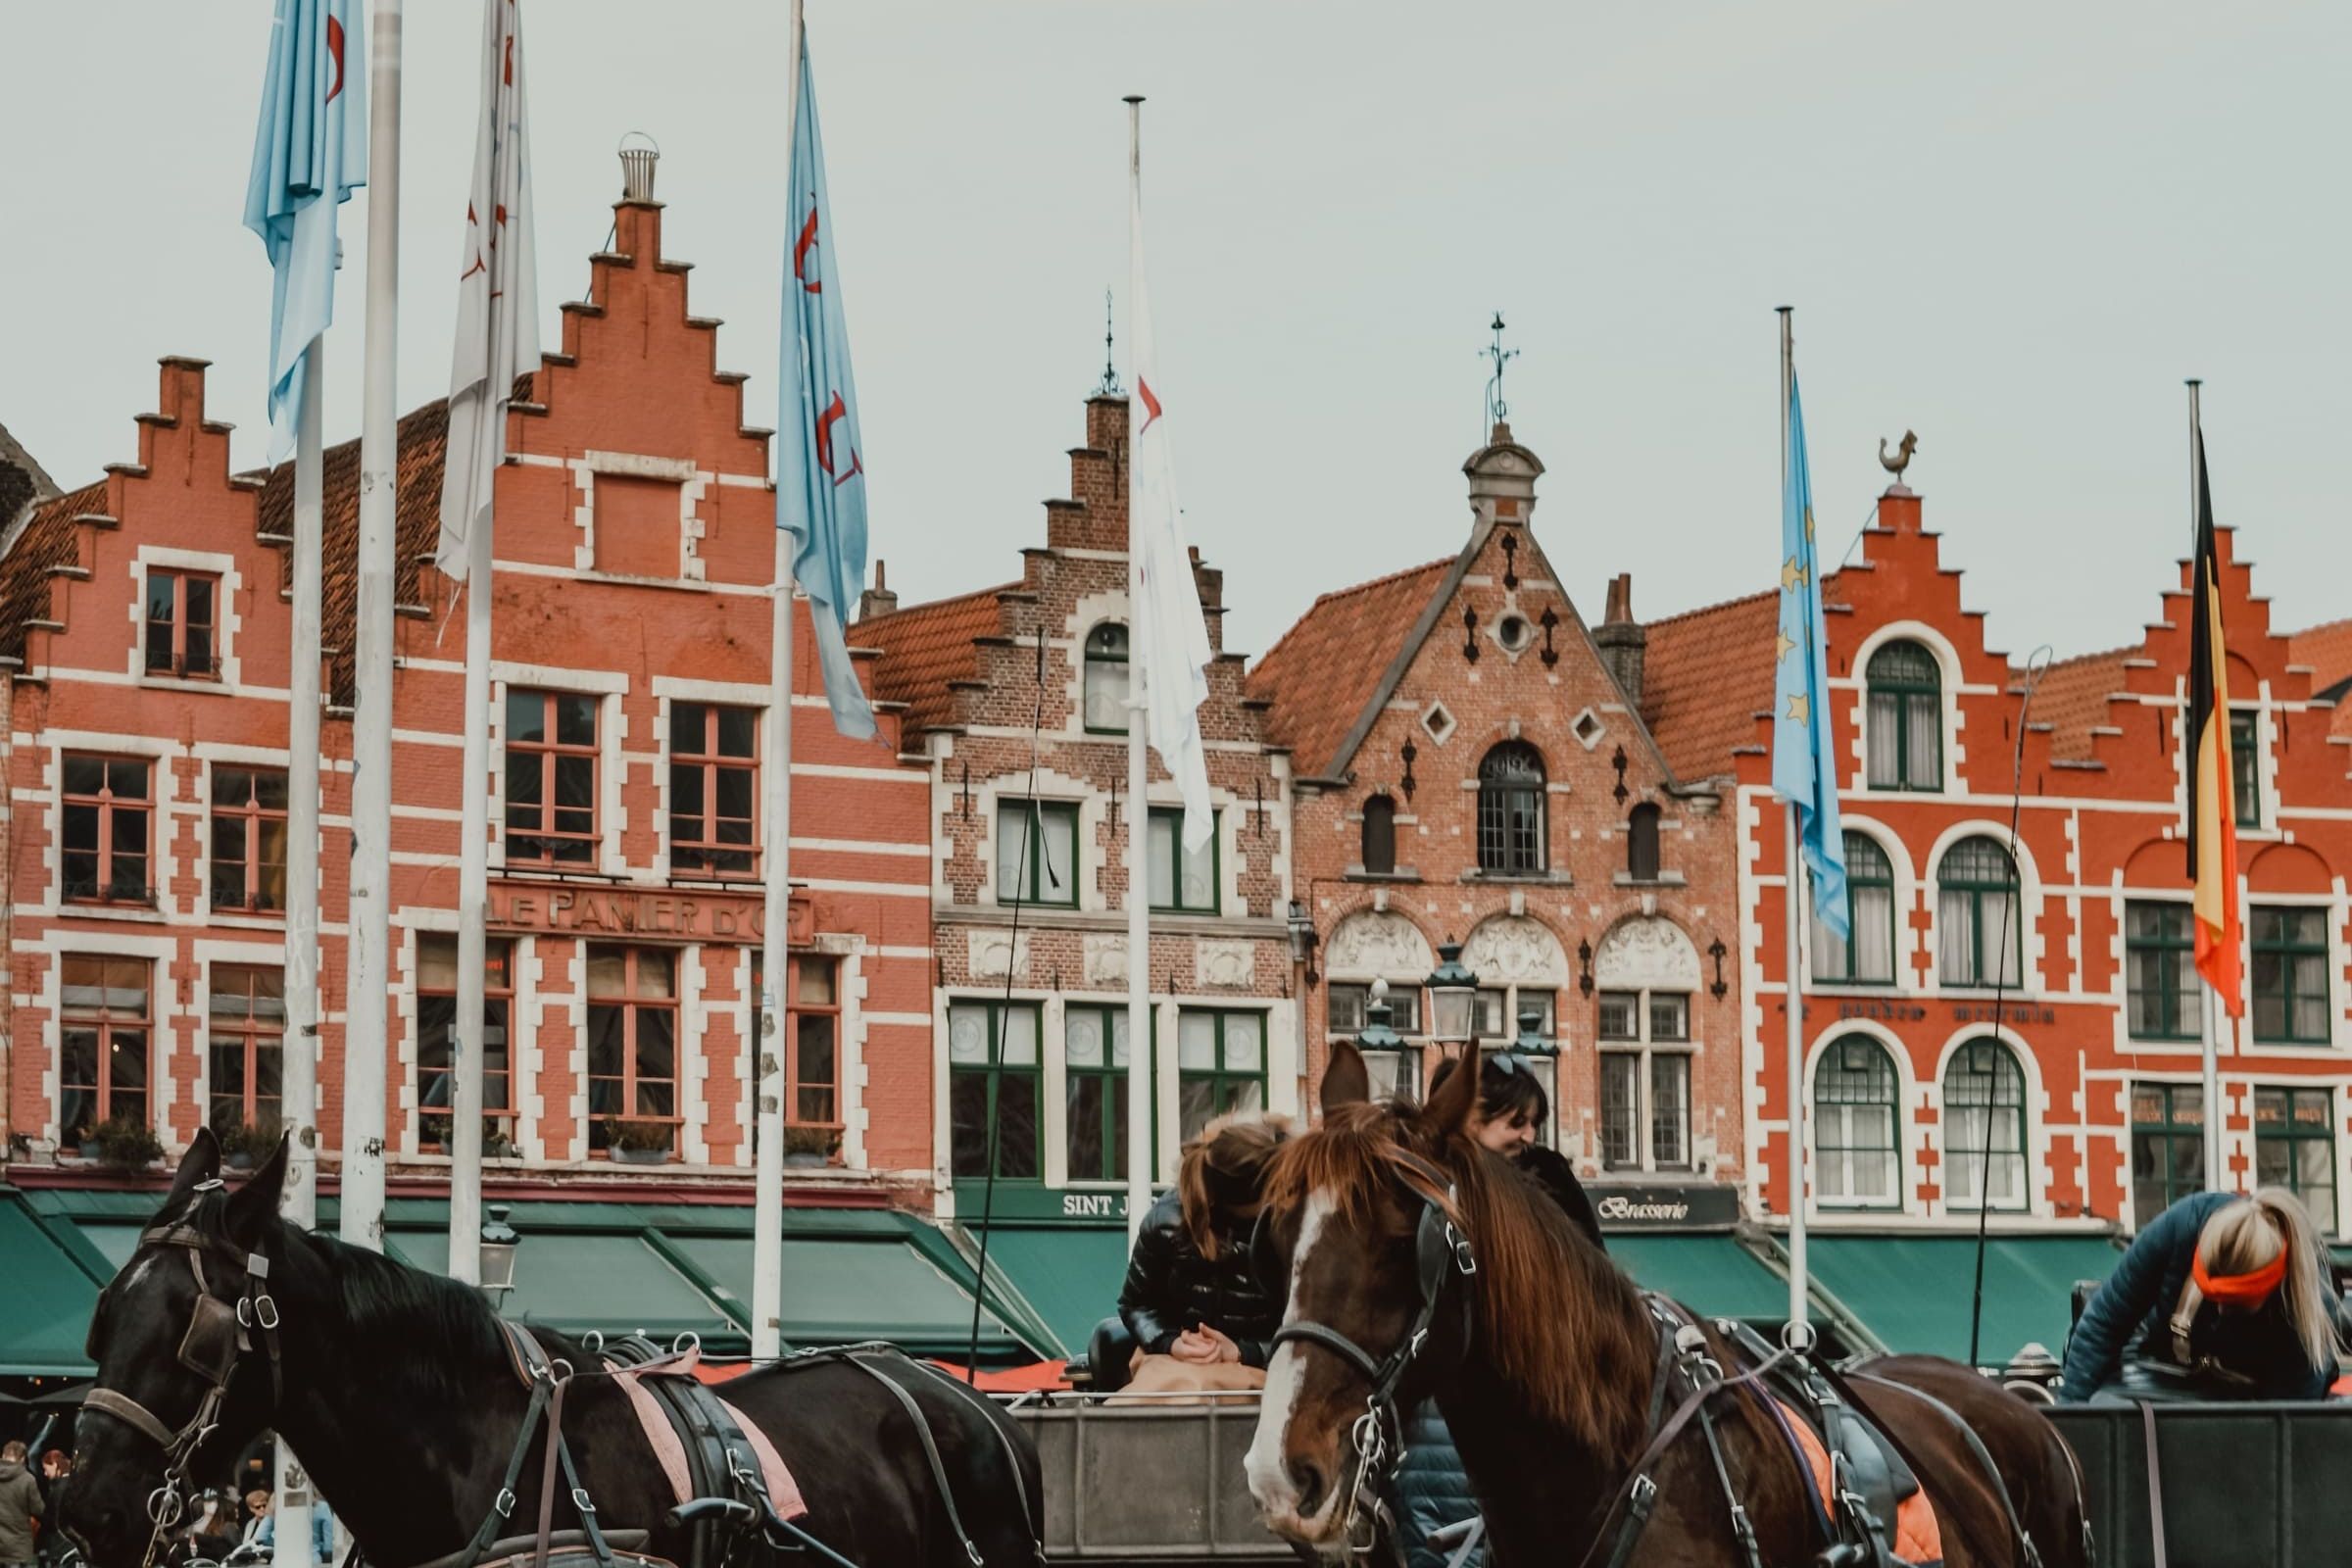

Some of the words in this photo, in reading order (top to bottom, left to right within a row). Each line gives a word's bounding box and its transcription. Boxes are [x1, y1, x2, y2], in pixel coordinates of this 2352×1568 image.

[485, 893, 535, 925] LE
[548, 890, 699, 933] PANIER
[1063, 1195, 1112, 1216] SINT
[1597, 1196, 1689, 1220] Brasserie
